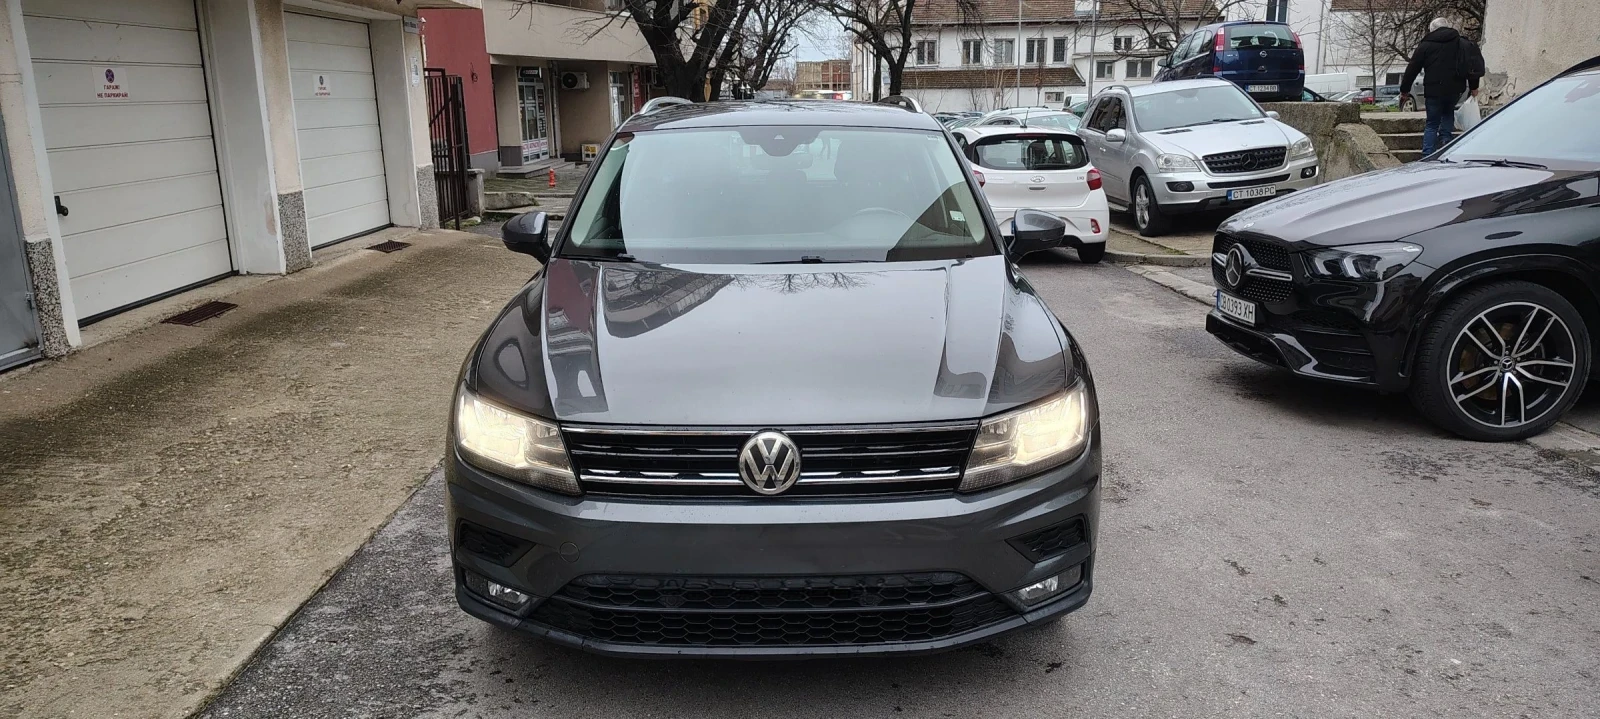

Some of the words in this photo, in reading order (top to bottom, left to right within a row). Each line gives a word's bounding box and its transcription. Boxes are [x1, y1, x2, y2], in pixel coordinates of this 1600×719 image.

[1233, 190, 1243, 198] CT
[1246, 188, 1263, 197] 1038
[1264, 186, 1275, 195] PC
[1227, 297, 1241, 315] 0393
[1243, 302, 1254, 320] XH
[739, 431, 801, 495] VW
